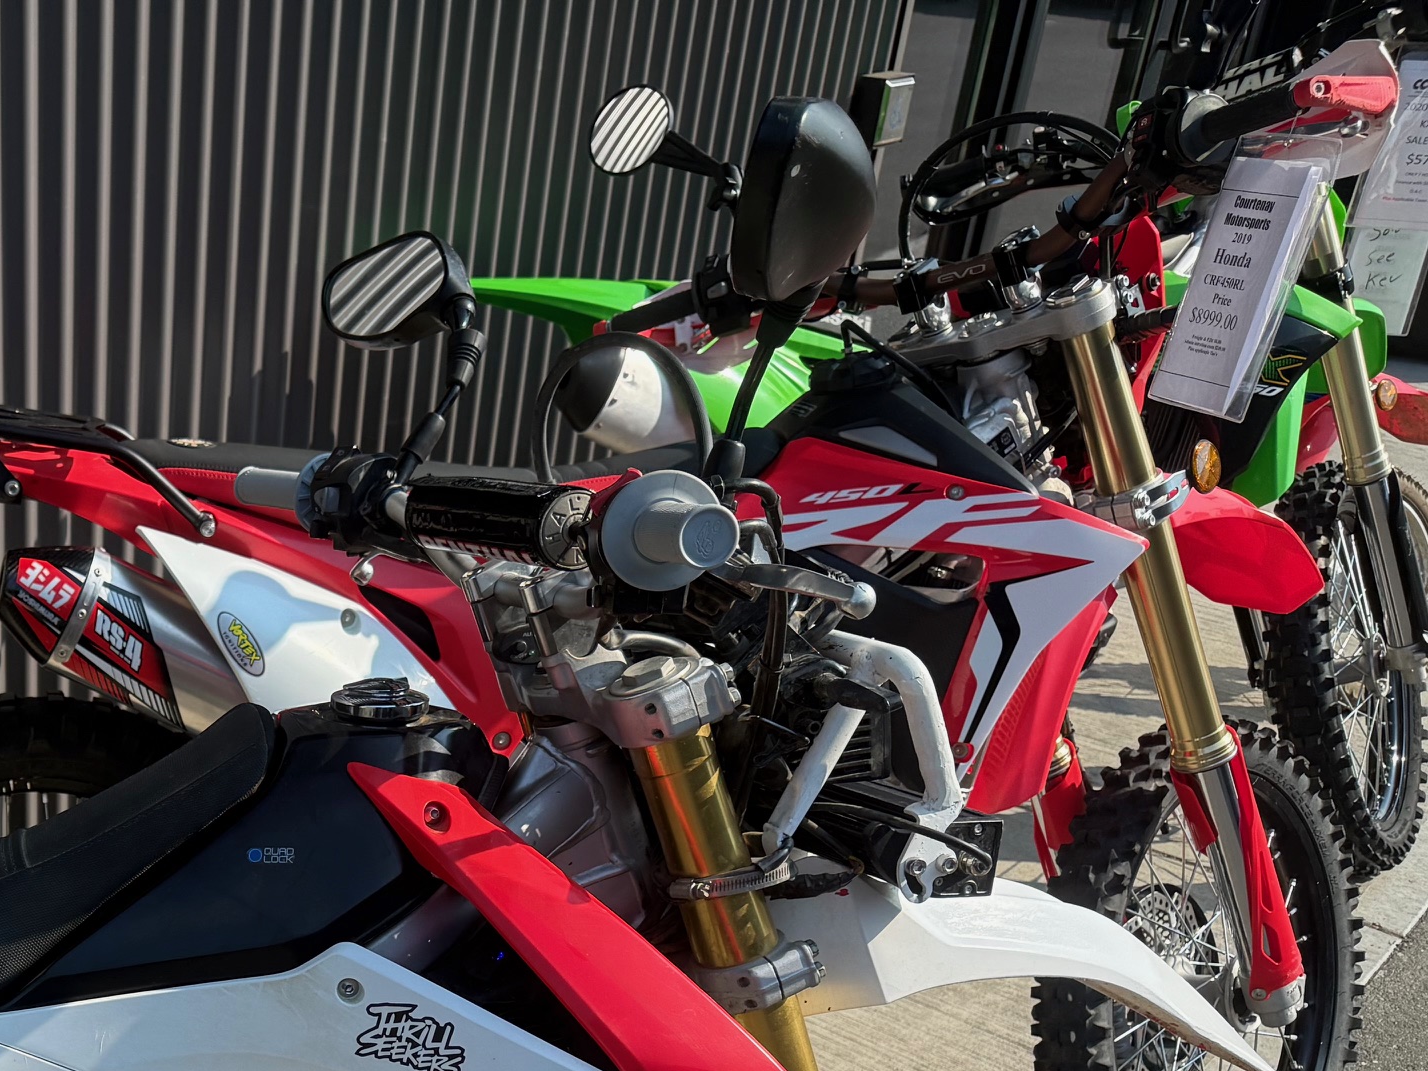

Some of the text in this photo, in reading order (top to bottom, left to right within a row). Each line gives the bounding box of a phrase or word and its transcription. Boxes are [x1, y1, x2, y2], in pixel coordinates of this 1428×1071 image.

[1405, 136, 1428, 145] SALE
[1234, 195, 1275, 213] Courtenay
[1224, 212, 1271, 231] Motorsports
[1232, 232, 1252, 244] 2019
[1213, 248, 1252, 268] Honda
[937, 264, 986, 284] EVO
[1204, 273, 1245, 291] CRF450RL
[1212, 293, 1232, 307] Price
[1189, 307, 1238, 331] $8999.00
[263, 847, 295, 856] QUAD
[263, 855, 294, 864] LOCK
